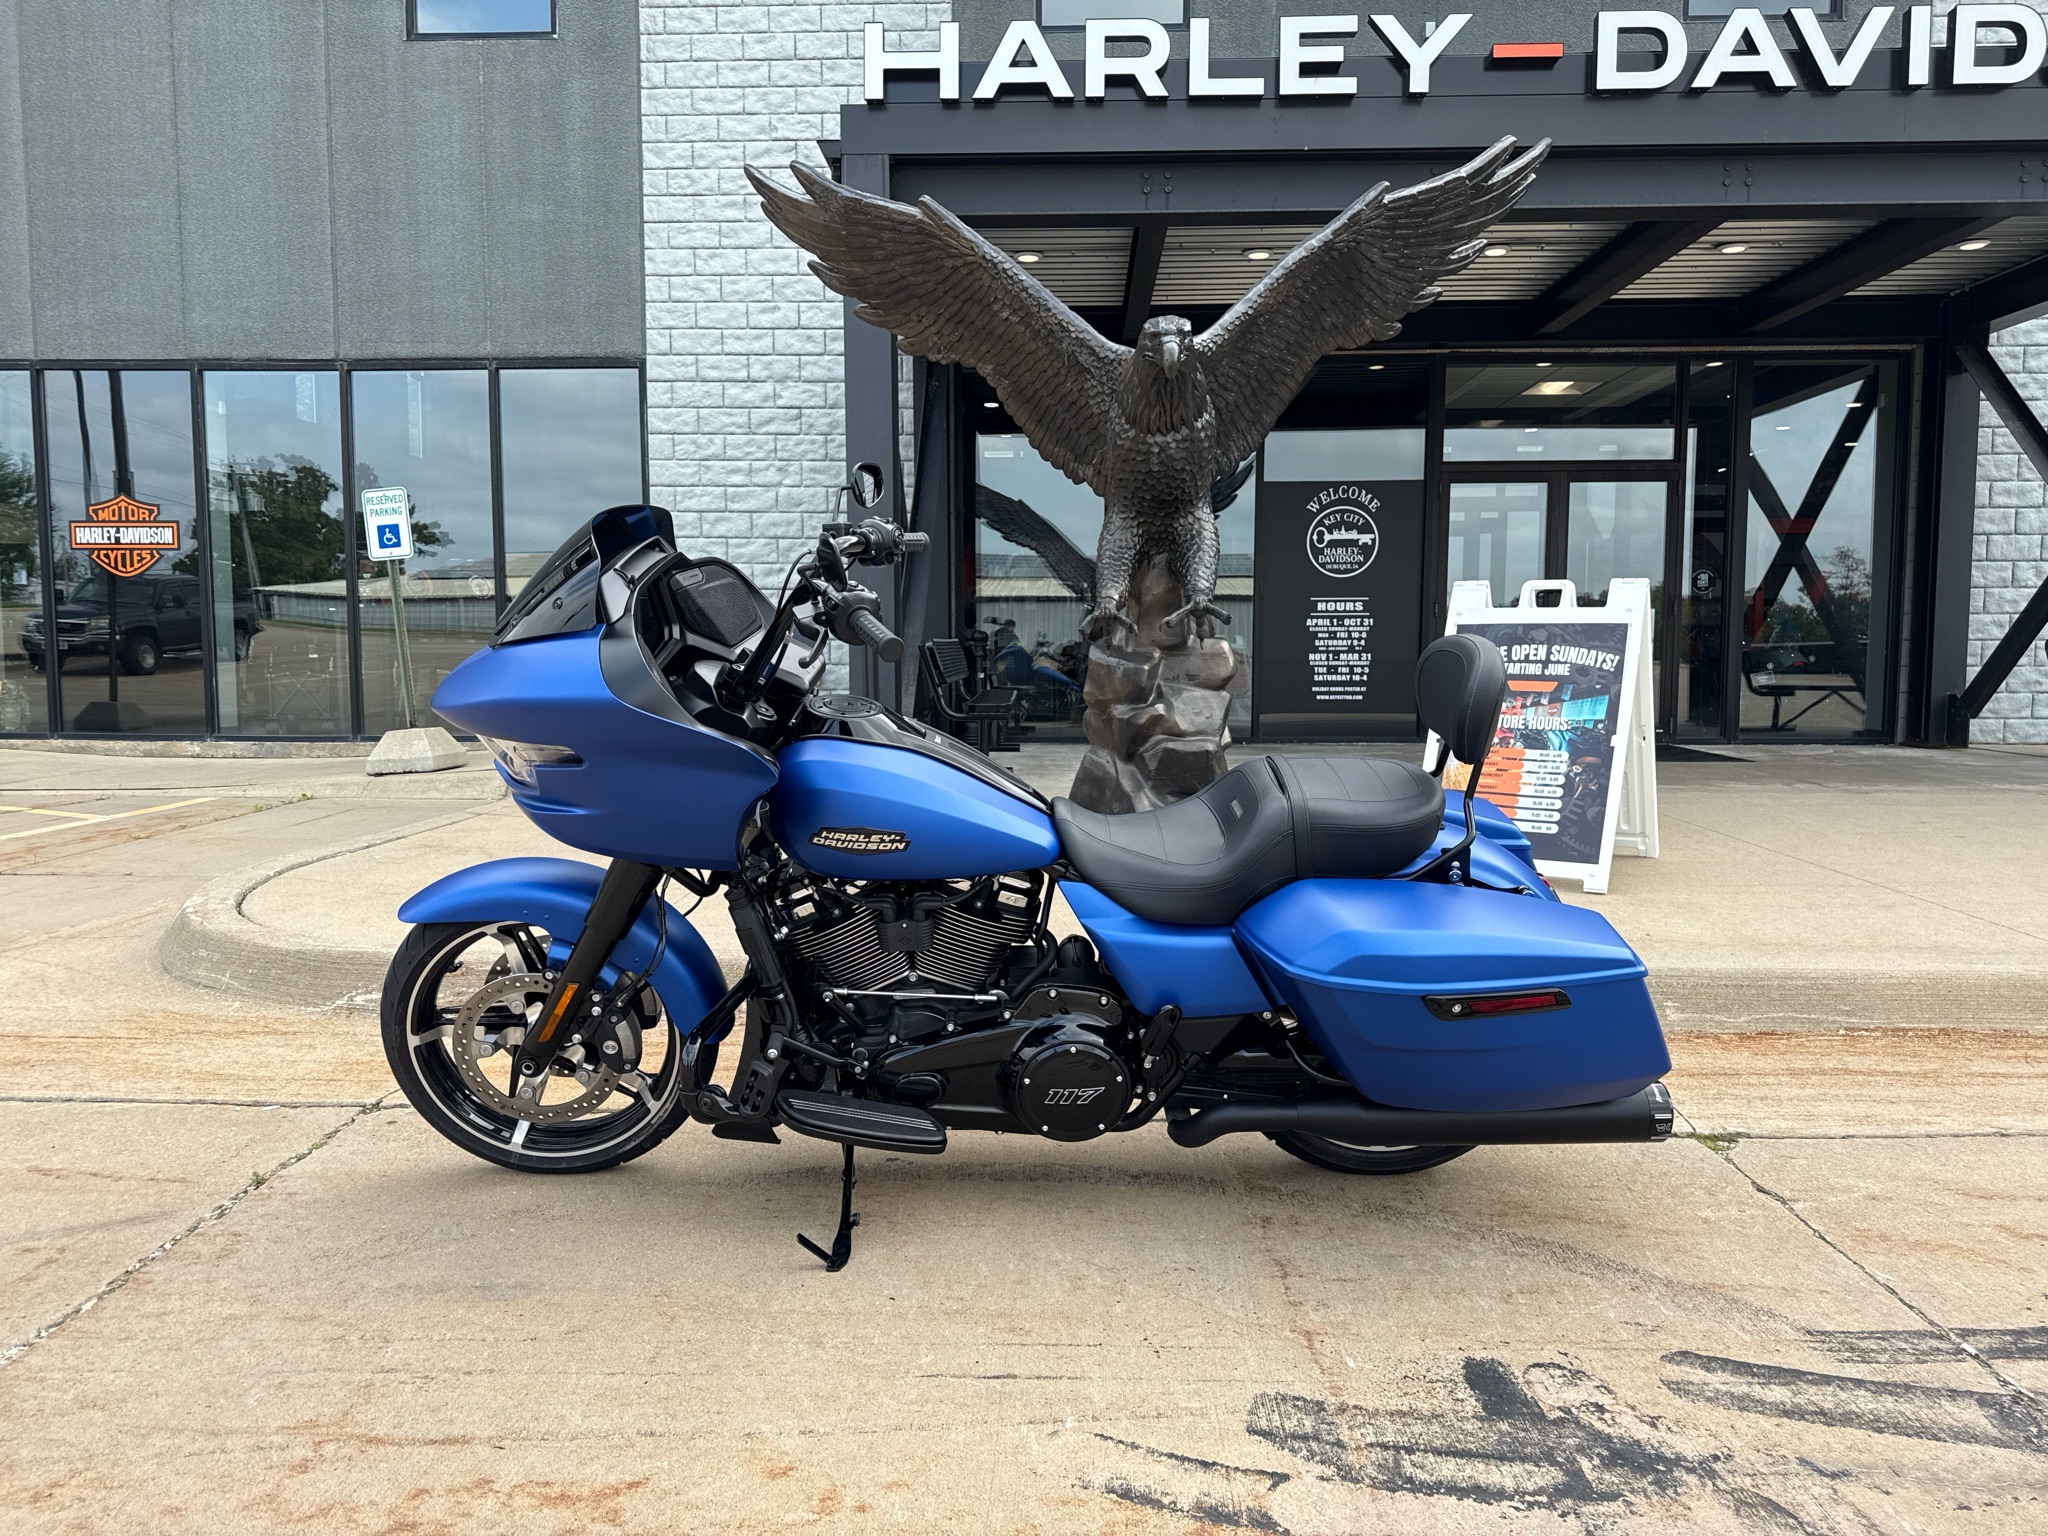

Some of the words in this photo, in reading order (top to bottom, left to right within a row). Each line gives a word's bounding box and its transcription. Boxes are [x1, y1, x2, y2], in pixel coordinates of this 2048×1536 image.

[366, 494, 404, 505] RESERVED
[1306, 485, 1380, 512] WELCOME
[98, 500, 150, 520] MOTOR
[370, 506, 403, 517] PARKING
[1323, 513, 1341, 526] KEY
[1343, 513, 1365, 526] CITY
[75, 527, 173, 544] HARLEY-DAVIDSON
[1323, 547, 1362, 556] HARLEY-
[99, 550, 151, 572] CYCLES
[1318, 554, 1364, 563] DAVIDSON
[1317, 602, 1364, 611] HOURS
[1306, 618, 1331, 626] APRIL
[1332, 618, 1337, 626] 1
[1343, 618, 1361, 626] OCT
[1362, 618, 1374, 626] 31
[1309, 653, 1327, 661] NOV
[1328, 653, 1333, 661] 1
[1339, 653, 1359, 661] MAR
[1511, 644, 1547, 661] OPEN
[1550, 645, 1620, 672] SUNDAYS!
[1504, 662, 1542, 676] TARTING
[1544, 663, 1571, 676] JUNE
[1497, 715, 1526, 729] TORE
[1527, 716, 1573, 731] HOURS:
[821, 830, 901, 842] HARLEY-
[812, 837, 907, 850] DAVIDSON
[1044, 1086, 1106, 1105] 117
